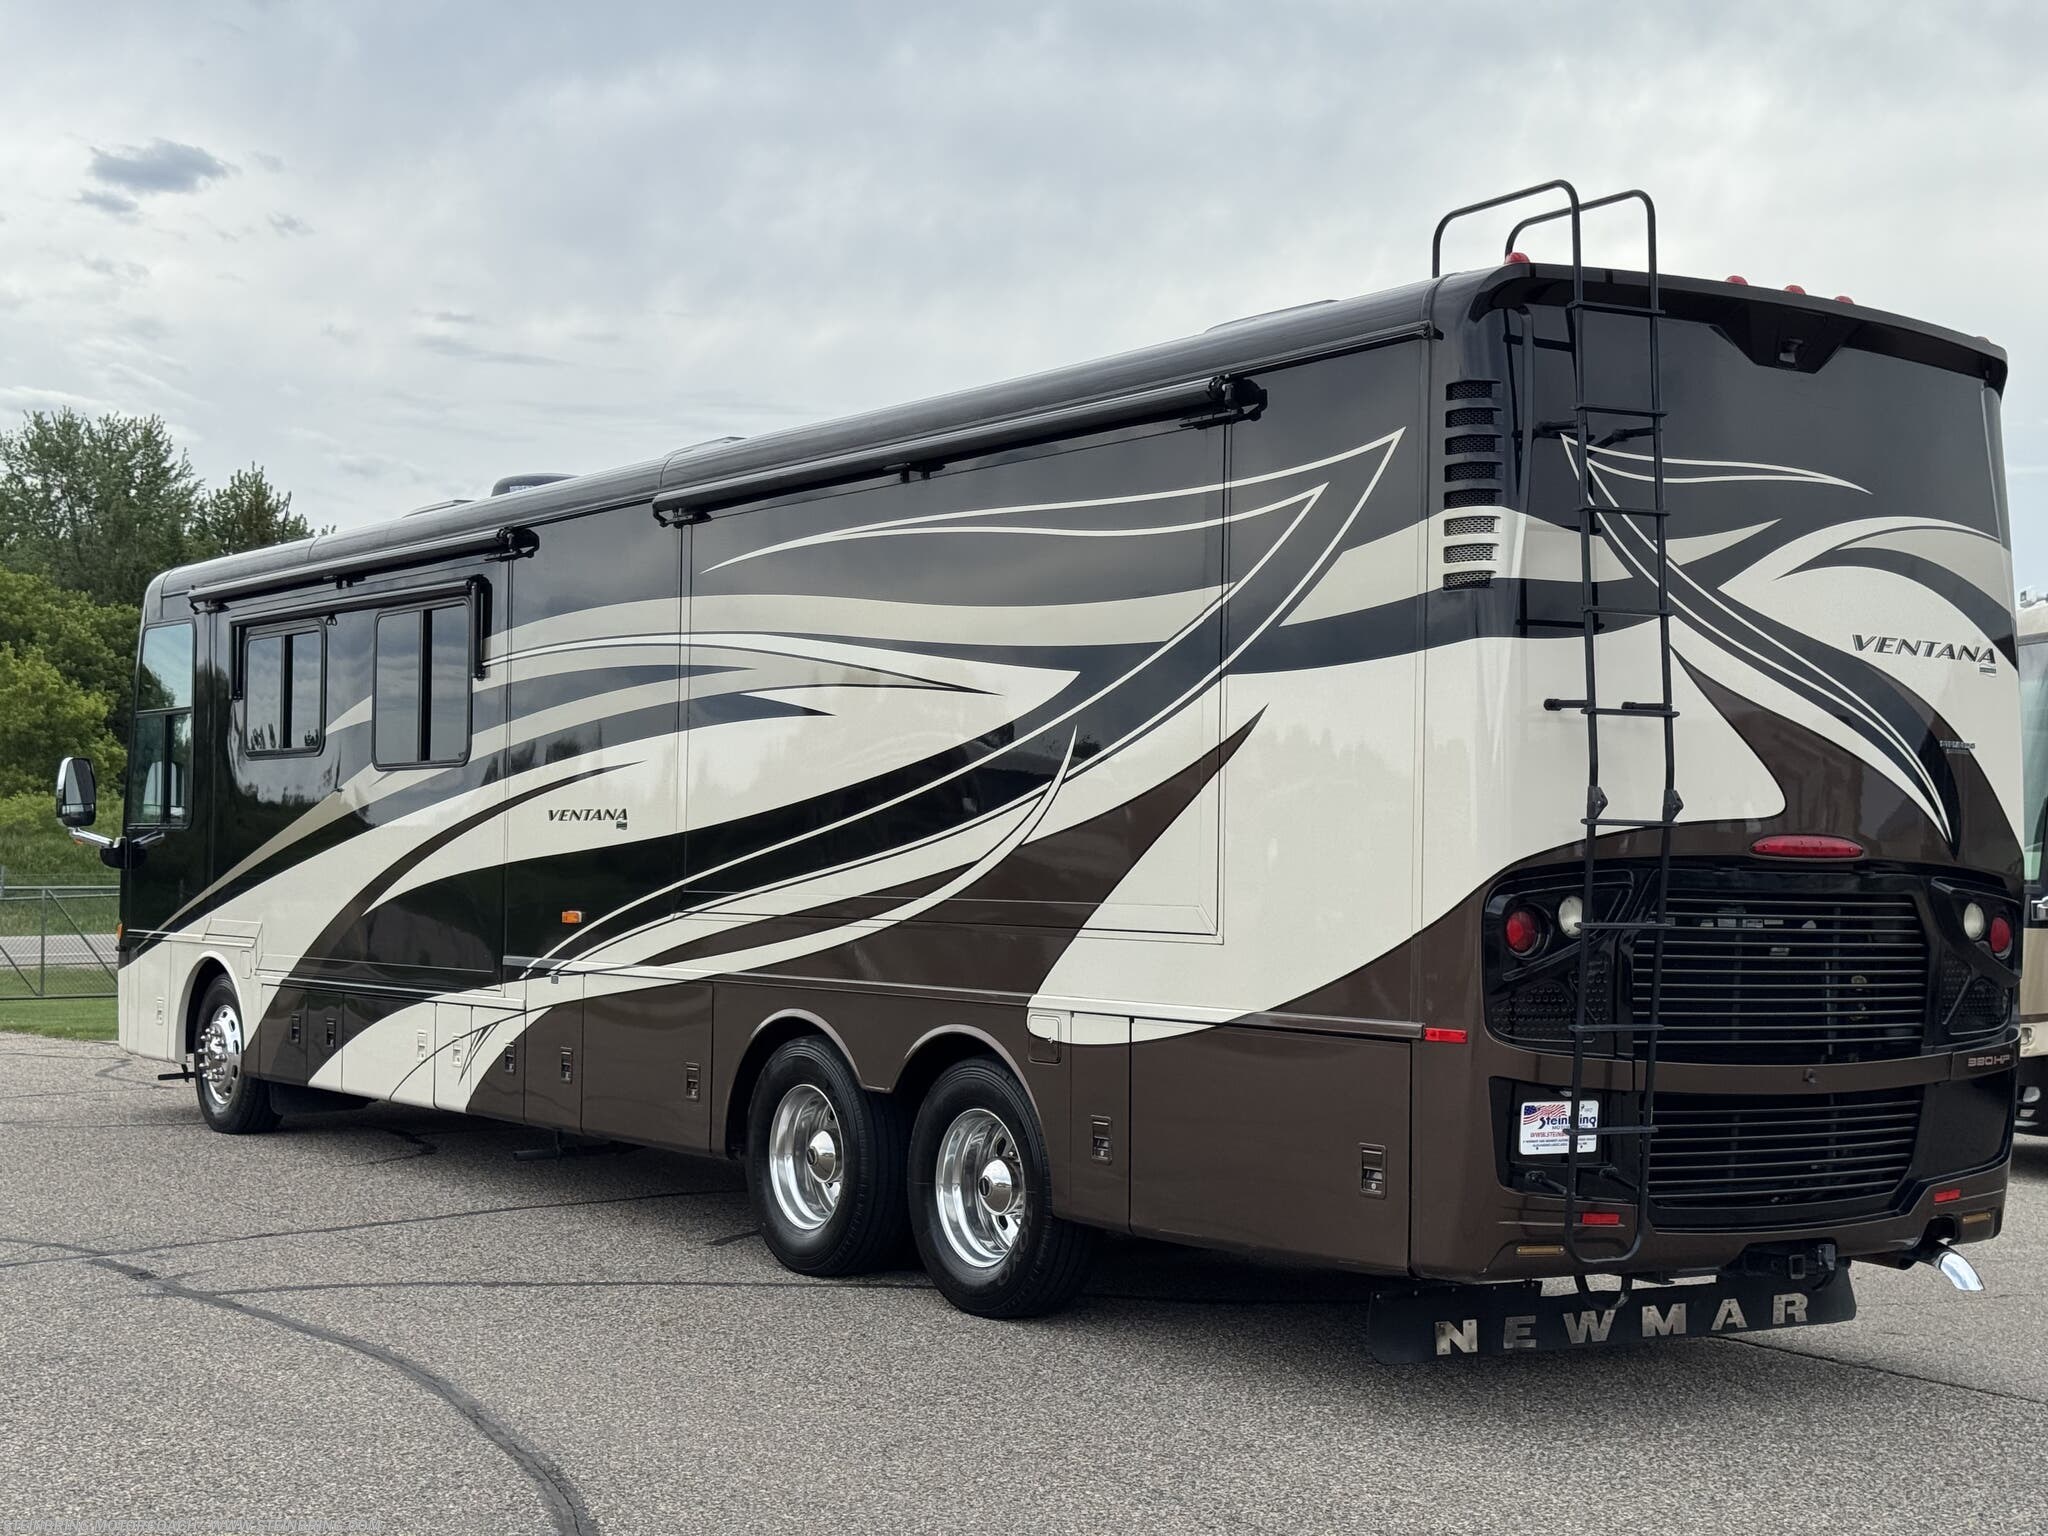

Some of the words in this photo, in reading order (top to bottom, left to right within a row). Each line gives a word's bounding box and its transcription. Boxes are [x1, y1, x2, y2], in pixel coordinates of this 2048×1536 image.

[1852, 634, 1997, 664] VENTANA
[548, 808, 627, 822] VENTANA
[1434, 1292, 1808, 1356] NEWMAR
